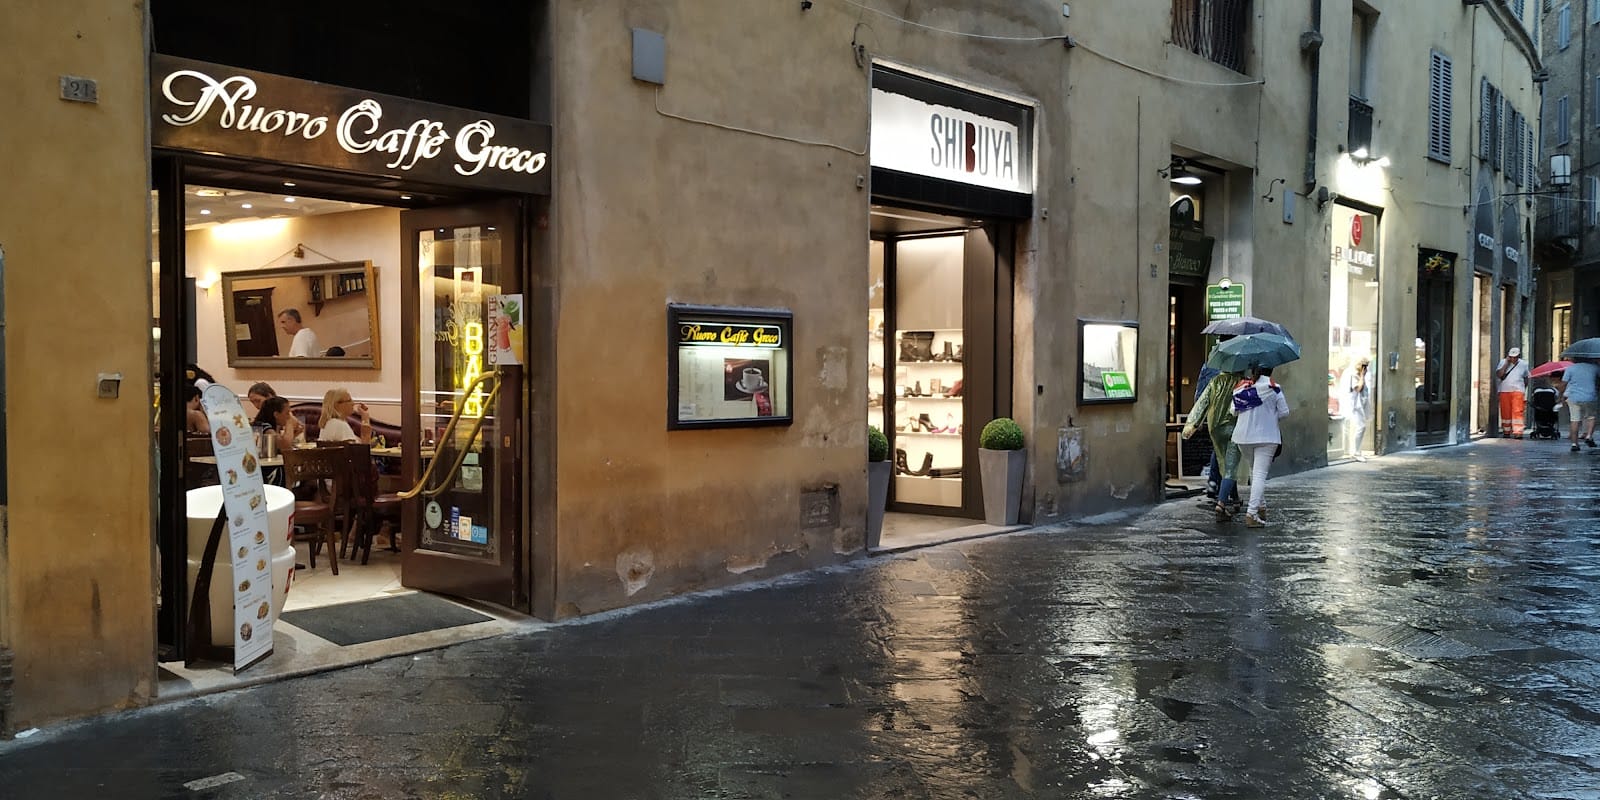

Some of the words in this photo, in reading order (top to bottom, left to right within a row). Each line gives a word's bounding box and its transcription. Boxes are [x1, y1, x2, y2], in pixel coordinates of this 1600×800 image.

[161, 70, 329, 140] Nuovo
[336, 99, 450, 170] Caffè
[454, 120, 546, 175] Greco
[931, 113, 1013, 180] SHIBUYA
[489, 296, 498, 364] GRANITE
[681, 325, 717, 341] Nuovo
[753, 327, 778, 345] Greco
